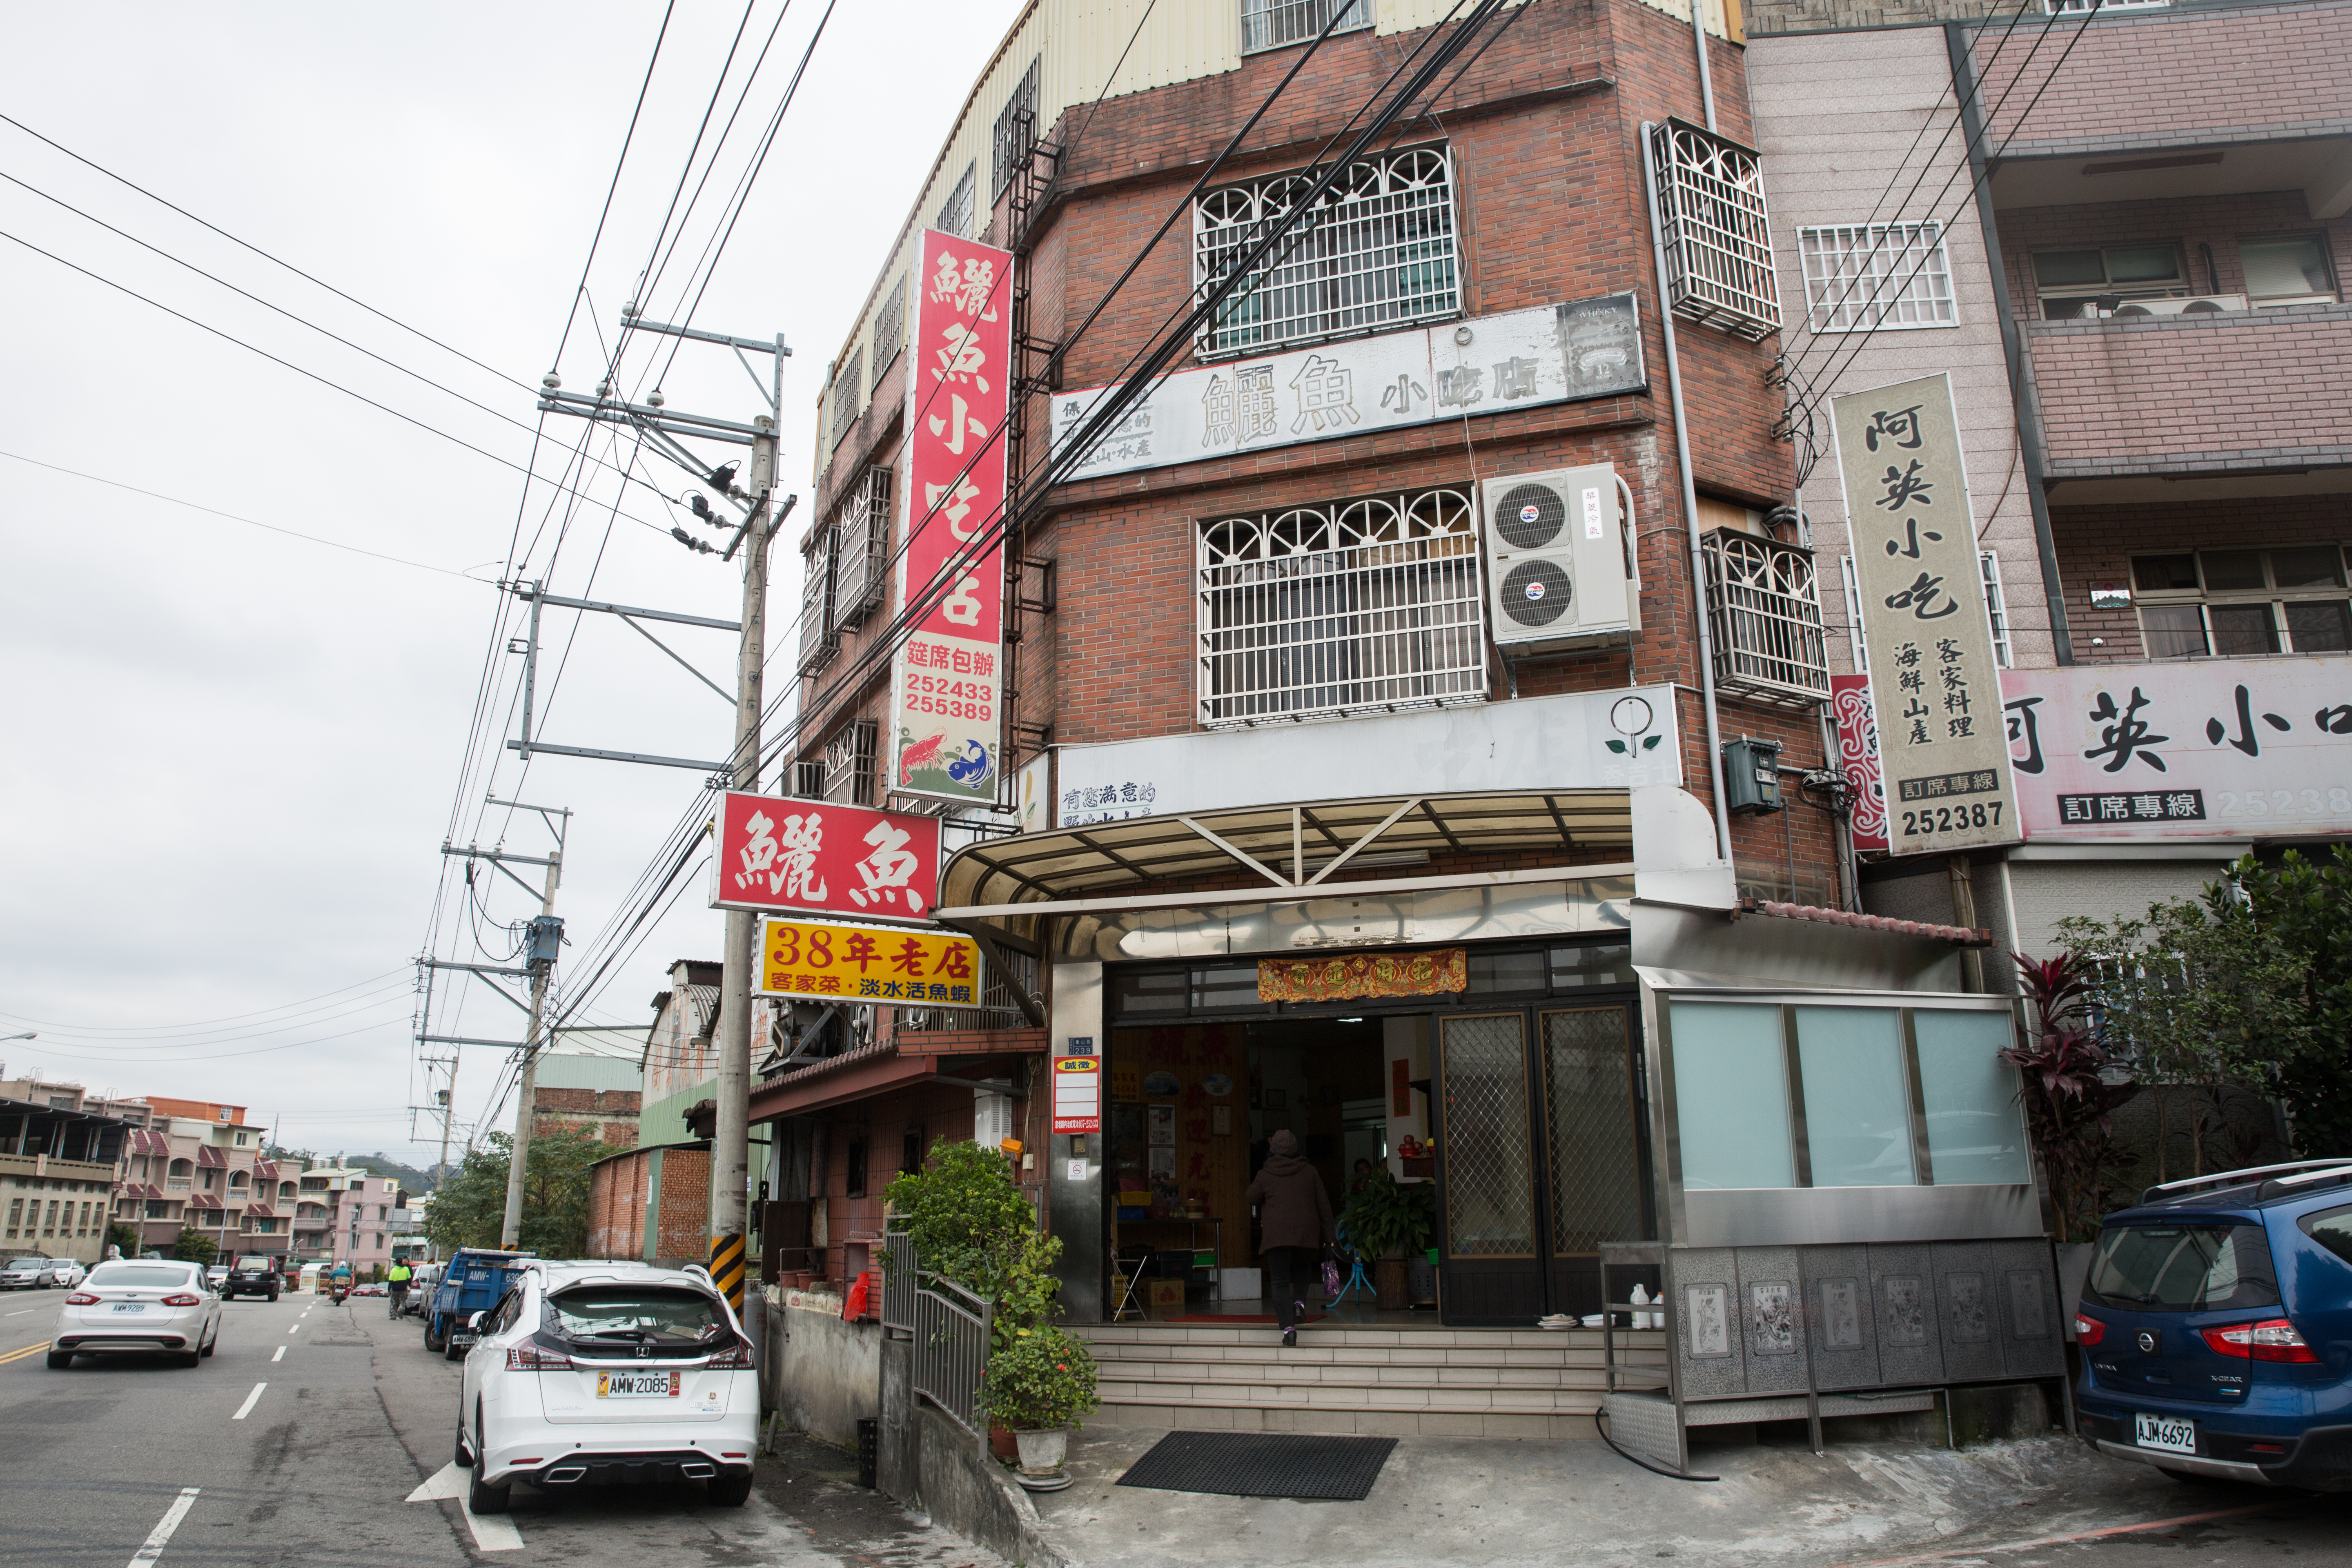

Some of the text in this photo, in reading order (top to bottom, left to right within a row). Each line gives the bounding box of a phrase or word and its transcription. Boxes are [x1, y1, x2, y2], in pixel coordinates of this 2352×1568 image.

[1598, 364, 1610, 375] 12
[922, 250, 998, 626] 鱺魚小吃店
[1586, 492, 1599, 535] 華菱冷氣
[1866, 405, 1958, 619] 阿英小吃
[906, 639, 994, 677] 筵席包辦
[906, 673, 992, 702] 252433
[1894, 642, 1932, 746] 海鮮山產
[1937, 638, 1975, 737] 客家料理
[906, 693, 991, 721] 255389
[1764, 787, 1773, 798] 75
[1903, 772, 1994, 799] 訂席專線
[1902, 801, 2003, 836] 252387
[2065, 793, 2198, 820] 訂席專線
[735, 809, 923, 913] 鱺魚
[773, 927, 971, 979] 38年老店
[1065, 1061, 1090, 1069] 誠徵
[2094, 1363, 2117, 1371] LIVINA
